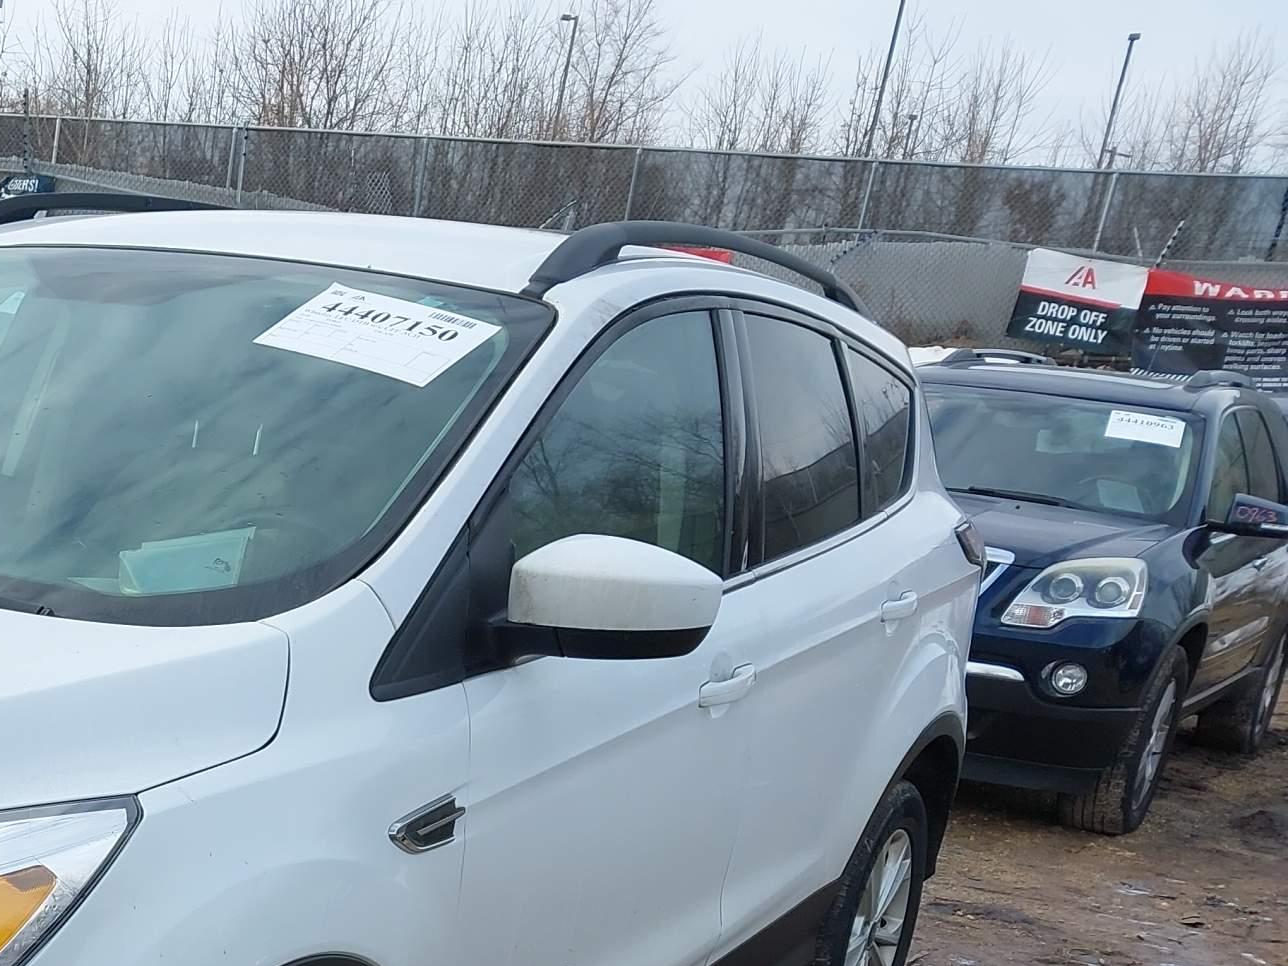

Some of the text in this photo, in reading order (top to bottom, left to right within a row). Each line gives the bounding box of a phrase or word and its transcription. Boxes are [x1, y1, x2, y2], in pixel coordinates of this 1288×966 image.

[1037, 301, 1108, 326] DROP OFF
[1158, 303, 1171, 311] Pay
[1171, 304, 1202, 312] attention
[322, 302, 459, 341] 44407150
[1024, 317, 1108, 344] ZONE ONLY
[1192, 329, 1215, 337] should
